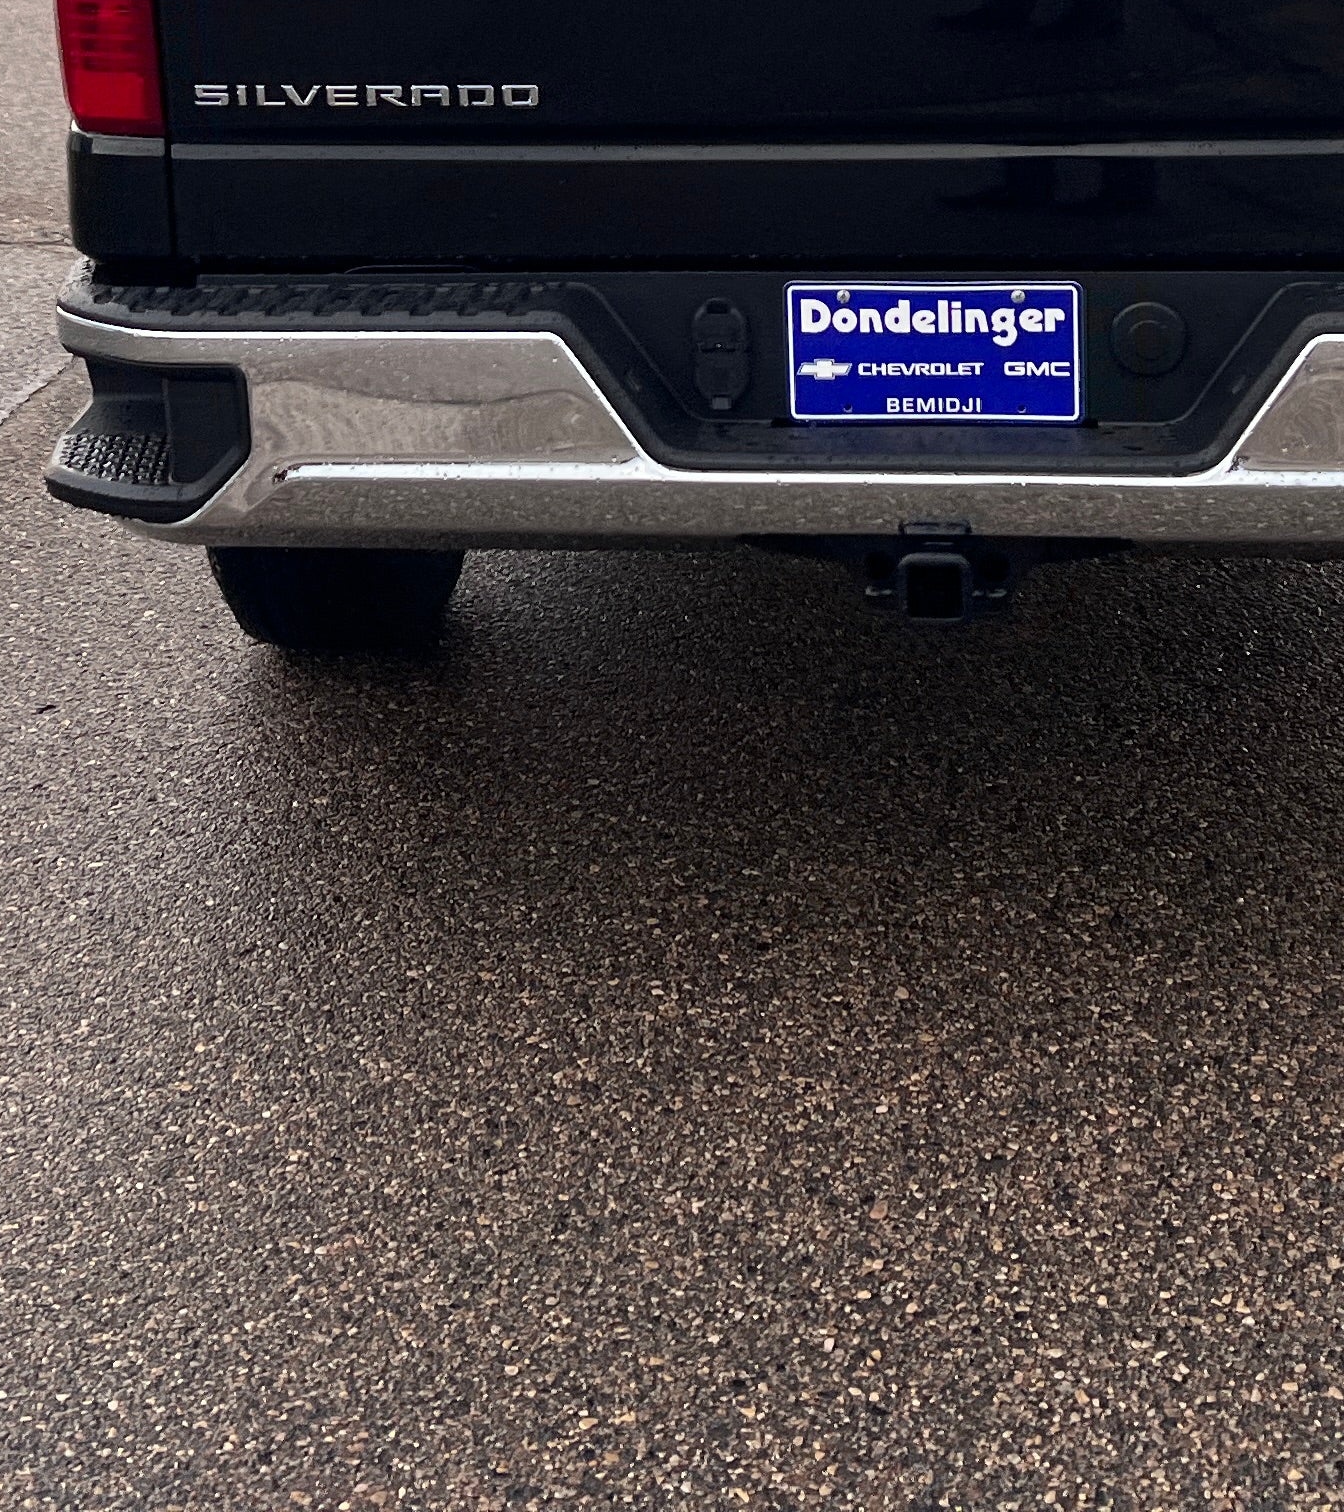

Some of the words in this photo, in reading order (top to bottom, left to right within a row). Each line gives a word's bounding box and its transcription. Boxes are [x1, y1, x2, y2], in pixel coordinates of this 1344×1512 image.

[193, 83, 540, 107] SILVERADO
[799, 298, 1066, 347] Dondelinger
[857, 361, 985, 377] CHEVROLET
[1003, 361, 1071, 377] GMC
[885, 397, 982, 414] BEMIDJI
